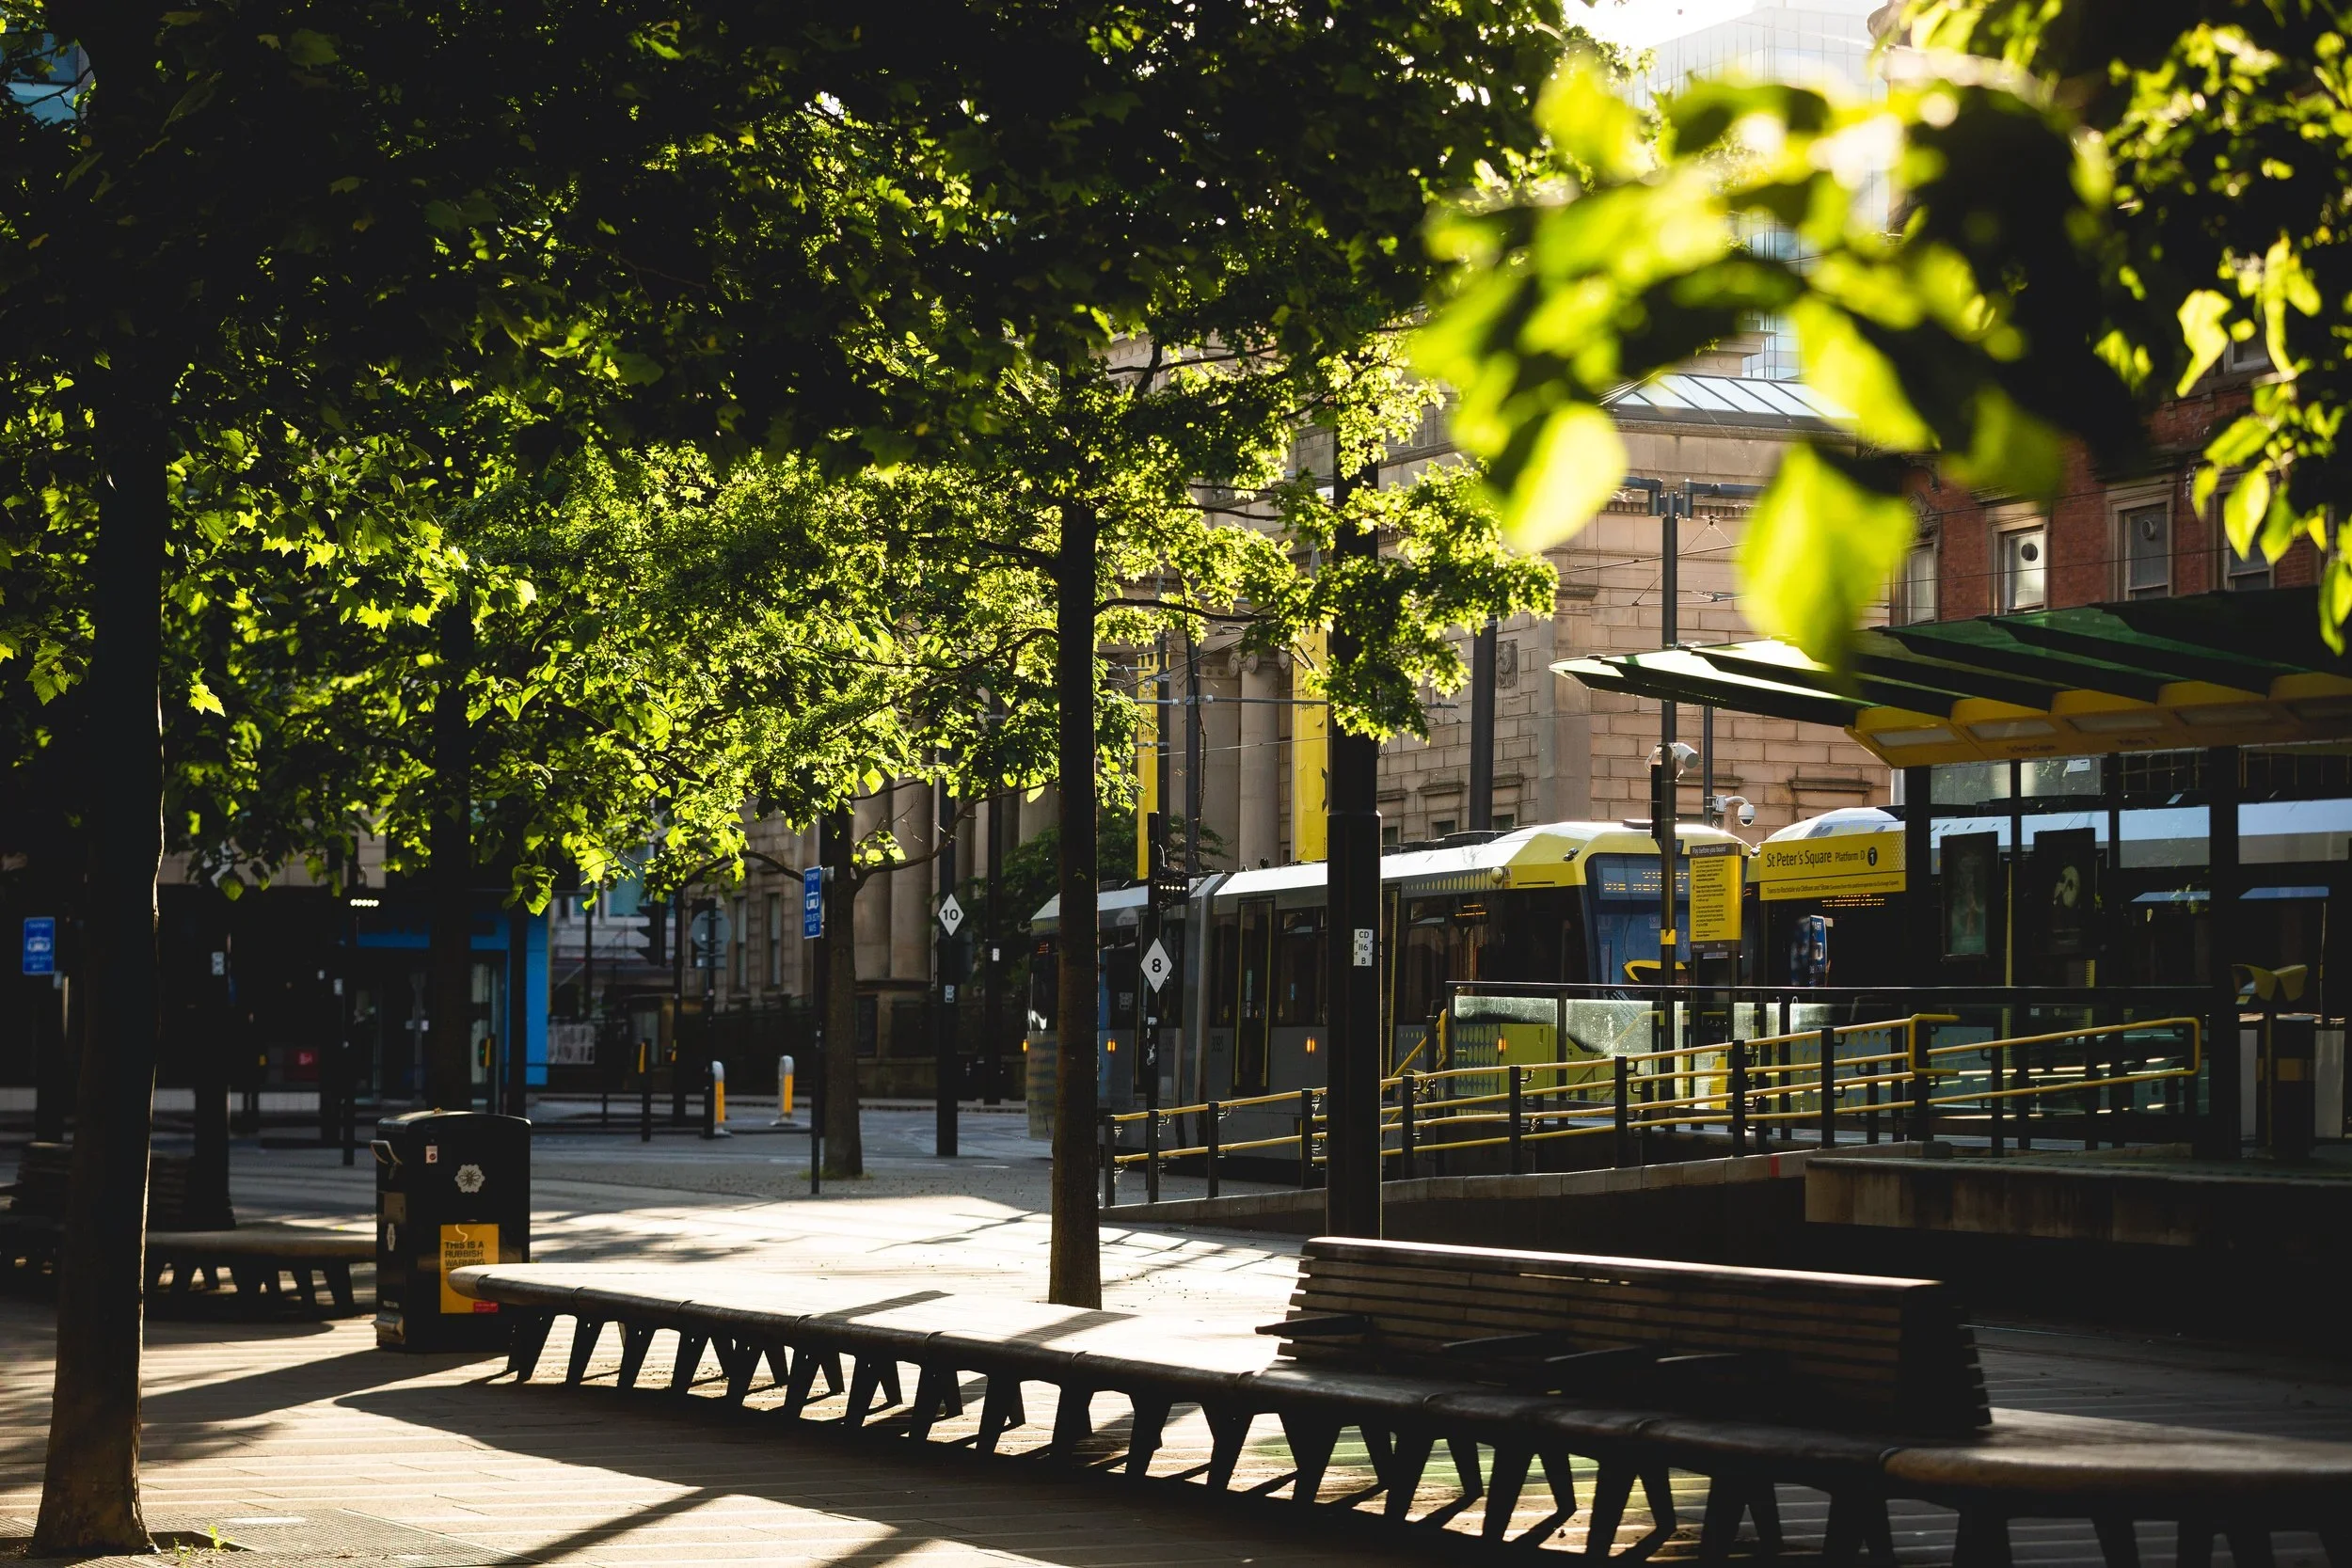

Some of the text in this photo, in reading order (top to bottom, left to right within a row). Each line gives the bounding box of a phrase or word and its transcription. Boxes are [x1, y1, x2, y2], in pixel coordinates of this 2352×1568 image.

[1767, 849, 1866, 868] St Peter's Square Platform D
[943, 909, 959, 921] 10
[1359, 930, 1370, 939] CD
[1361, 957, 1367, 965] B
[1152, 958, 1162, 974] 8
[445, 1241, 465, 1249] THIS
[468, 1241, 476, 1249] IS
[445, 1249, 484, 1258] RUBBISH
[445, 1259, 485, 1267] WARNING
